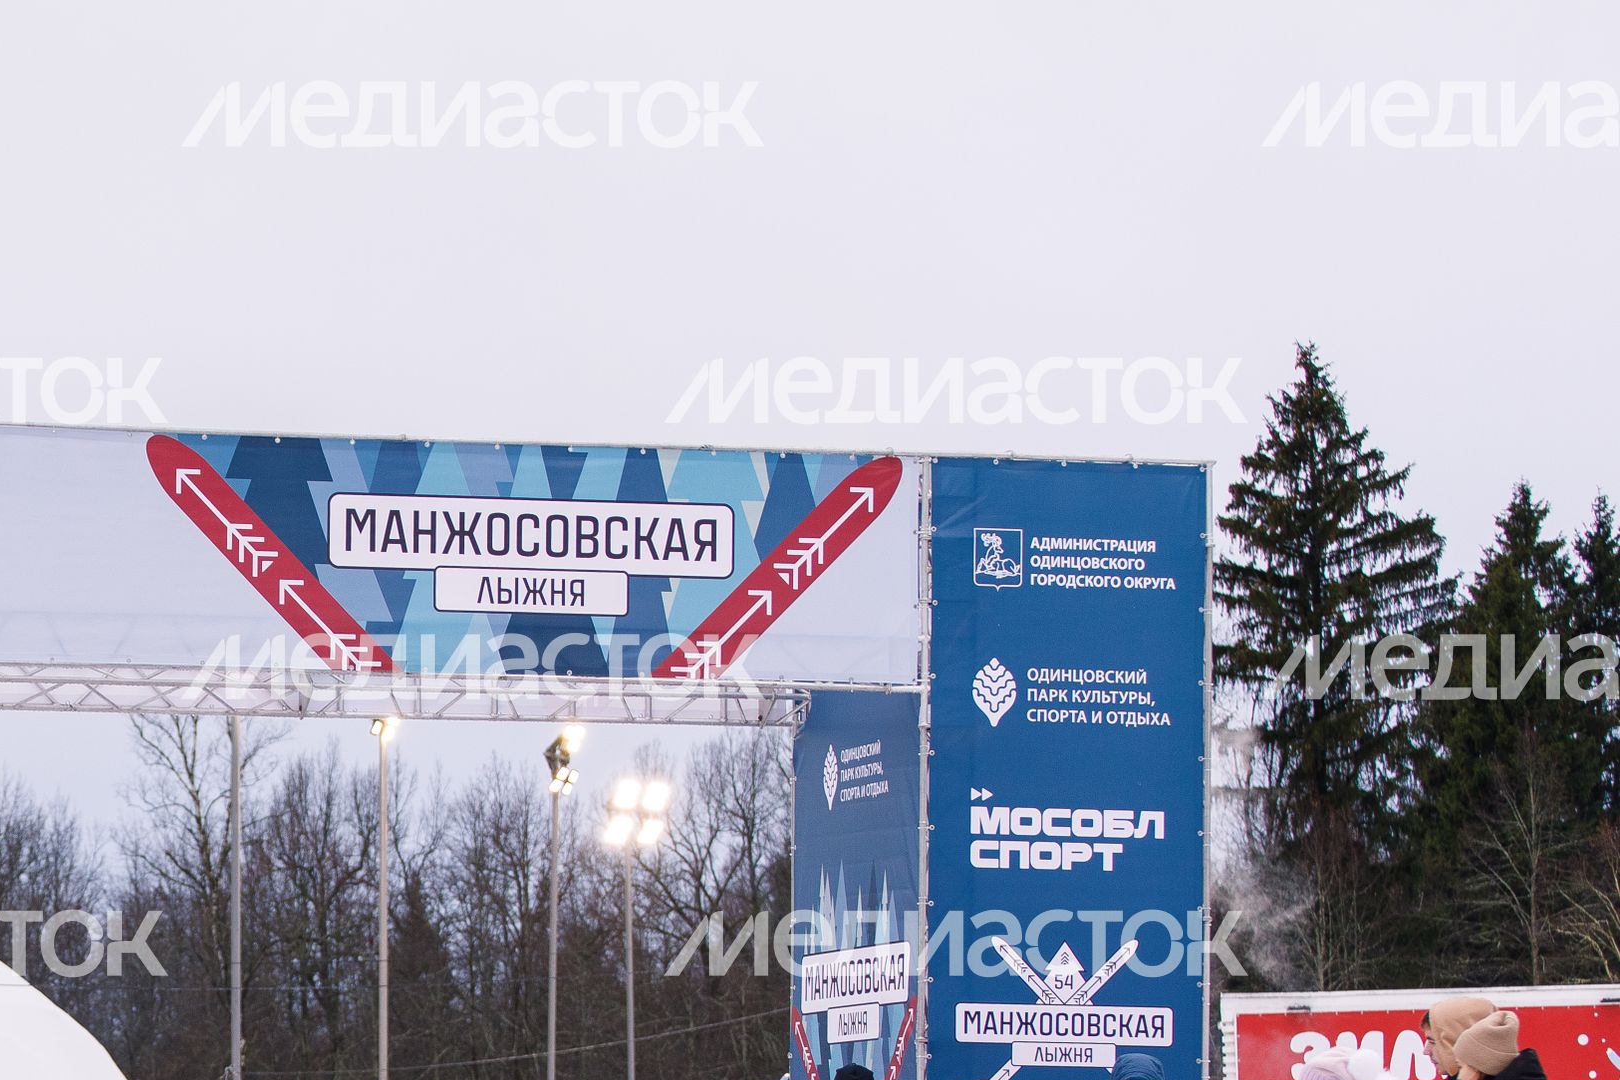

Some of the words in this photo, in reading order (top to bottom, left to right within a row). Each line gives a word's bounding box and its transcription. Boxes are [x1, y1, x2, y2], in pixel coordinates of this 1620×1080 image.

[344, 506, 719, 563] МАНЖОСОВСКАЯ
[1029, 536, 1157, 555] АДМИНИСТРАЦИЯ
[1029, 555, 1146, 572] ОДИНЦОВСКОГО
[476, 574, 586, 608] ЛЫЖНЯ
[1029, 573, 1121, 590] ГОРОДСКОГО
[1123, 574, 1177, 591] ОКРУГА
[1026, 666, 1148, 686] ОДИНЦОВСКИЙ
[1026, 687, 1069, 703] ПАРК
[1071, 688, 1157, 707] КУЛЬТУРЫ,
[1026, 708, 1088, 724] СПОРТА
[1091, 710, 1103, 724] И
[1105, 709, 1171, 728] ОТДЫХА
[840, 739, 881, 764] ОДИНЦОВСКИЙ
[840, 767, 855, 782] ПАРК
[840, 785, 860, 802] СПОРТА
[860, 785, 866, 798] И
[865, 780, 889, 798] ОТДЫХА
[970, 806, 1165, 839] МОСОБЛ
[969, 839, 1124, 872] СПОРТ
[804, 953, 905, 1002] МАНЖОСОВСКАЯ
[1054, 974, 1074, 991] 54
[837, 1010, 868, 1037] ЛЫЖНЯ
[964, 1010, 1165, 1039] МАНЖОСОВСКАЯ
[1034, 1045, 1093, 1063] ЛЫЖНЯ
